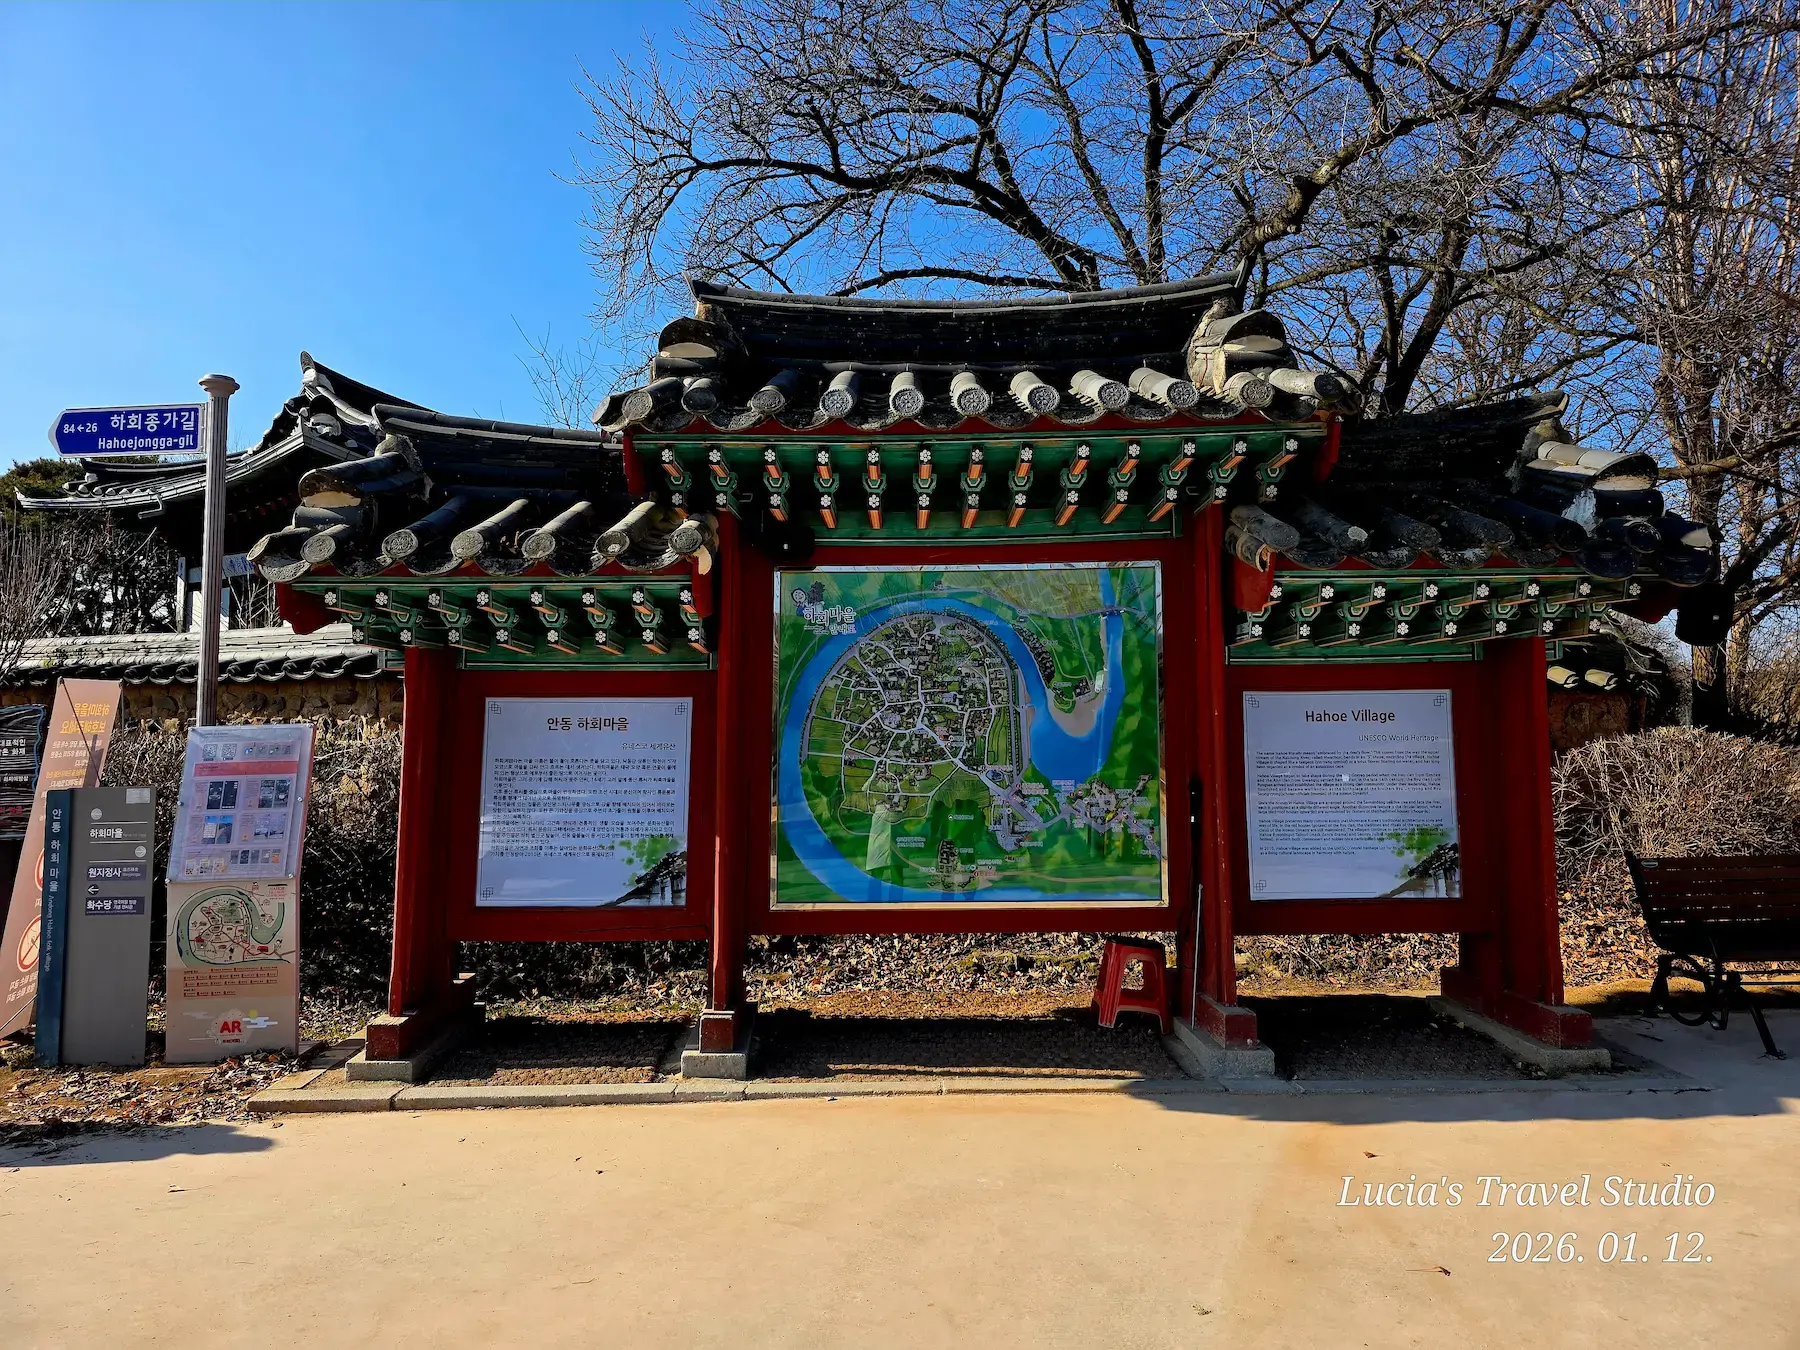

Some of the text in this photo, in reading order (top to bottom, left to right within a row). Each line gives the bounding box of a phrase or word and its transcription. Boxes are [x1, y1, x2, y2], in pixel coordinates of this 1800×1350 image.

[64, 423, 97, 433] 84 26
[110, 411, 194, 432] 하회종가길
[98, 435, 193, 450] Hahoejongga-gil
[803, 605, 856, 626] 하회마을
[829, 624, 856, 635] 안내도
[1306, 709, 1395, 723] Hahoe Village
[548, 717, 629, 731] 안동 하회마을
[90, 828, 123, 838] 하회마을
[50, 809, 62, 892] 안동 하회마을
[88, 868, 121, 878] 원지정사
[87, 900, 112, 910] 화수당
[220, 1021, 241, 1033] AR
